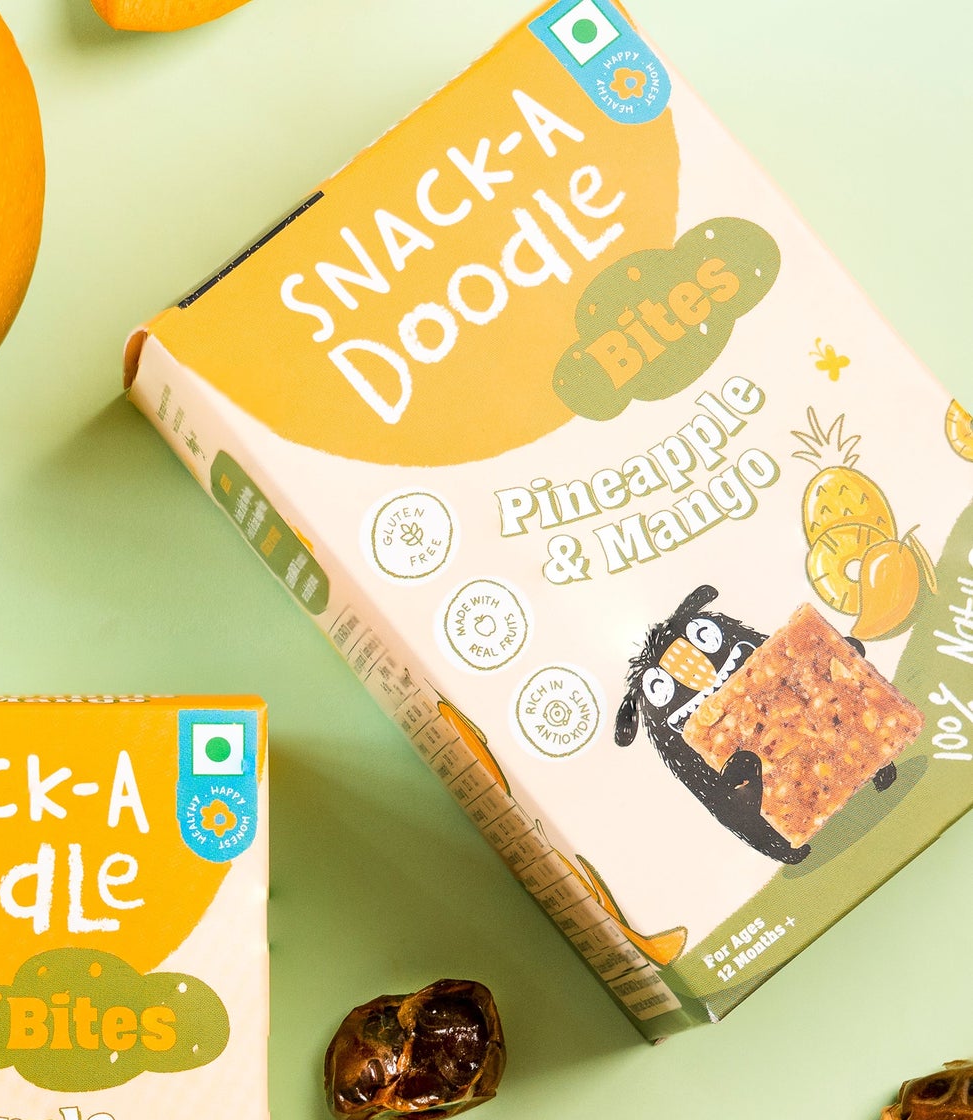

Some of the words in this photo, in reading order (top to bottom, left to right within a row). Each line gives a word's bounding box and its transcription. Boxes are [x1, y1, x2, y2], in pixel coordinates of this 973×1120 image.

[603, 51, 639, 69] HAPPY
[596, 79, 633, 114] HEALTHY
[645, 62, 660, 106] HONEST
[280, 89, 585, 343] SNACK-A
[584, 257, 741, 390] Bites
[494, 376, 766, 537] Pineapple
[382, 507, 425, 546] GLUTEN
[542, 534, 592, 585] &
[593, 448, 780, 575] Mango
[409, 538, 442, 567] FREE
[455, 603, 472, 637] MADE
[470, 595, 501, 609] WITH
[469, 643, 499, 658] REAL
[499, 613, 518, 651] FRUITS
[525, 685, 547, 715] RICH
[549, 680, 563, 690] IN
[535, 690, 591, 745] ANTIOXIDANTS
[211, 786, 246, 805] HAPPY
[187, 795, 206, 844] HEALTHY
[219, 816, 251, 849] HONEST
[702, 944, 731, 970] For
[730, 917, 765, 950] Ages
[717, 964, 737, 982] 12
[6, 990, 177, 1051] Bites
